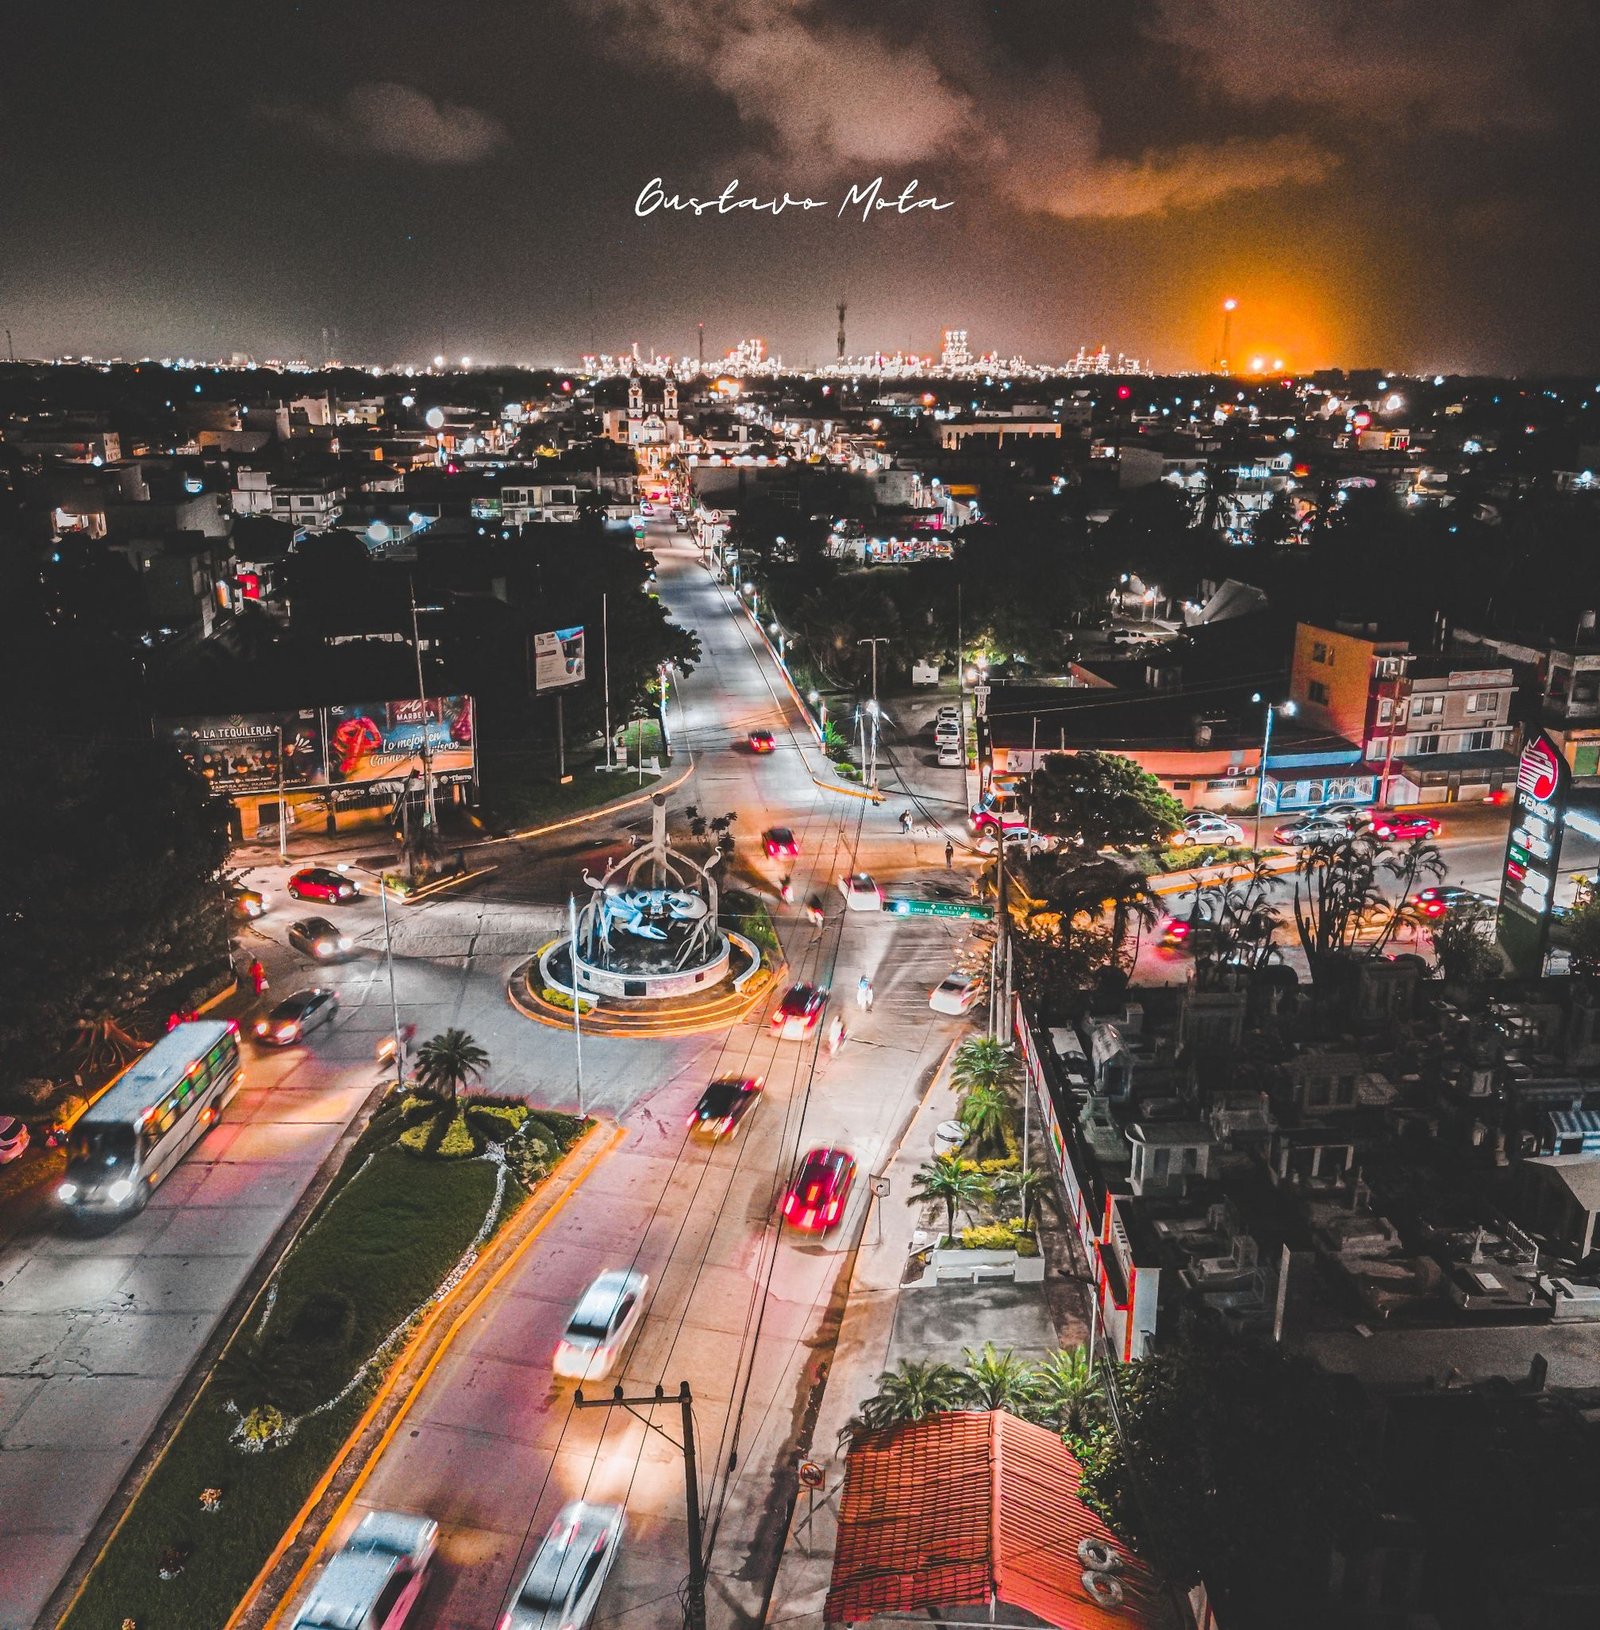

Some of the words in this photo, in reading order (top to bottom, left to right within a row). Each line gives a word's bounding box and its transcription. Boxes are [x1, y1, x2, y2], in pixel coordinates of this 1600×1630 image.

[203, 729, 216, 739] LA
[218, 725, 272, 738] TEQUILERIA
[383, 738, 396, 754] Lo
[397, 734, 426, 751] mejor
[428, 732, 441, 743] en
